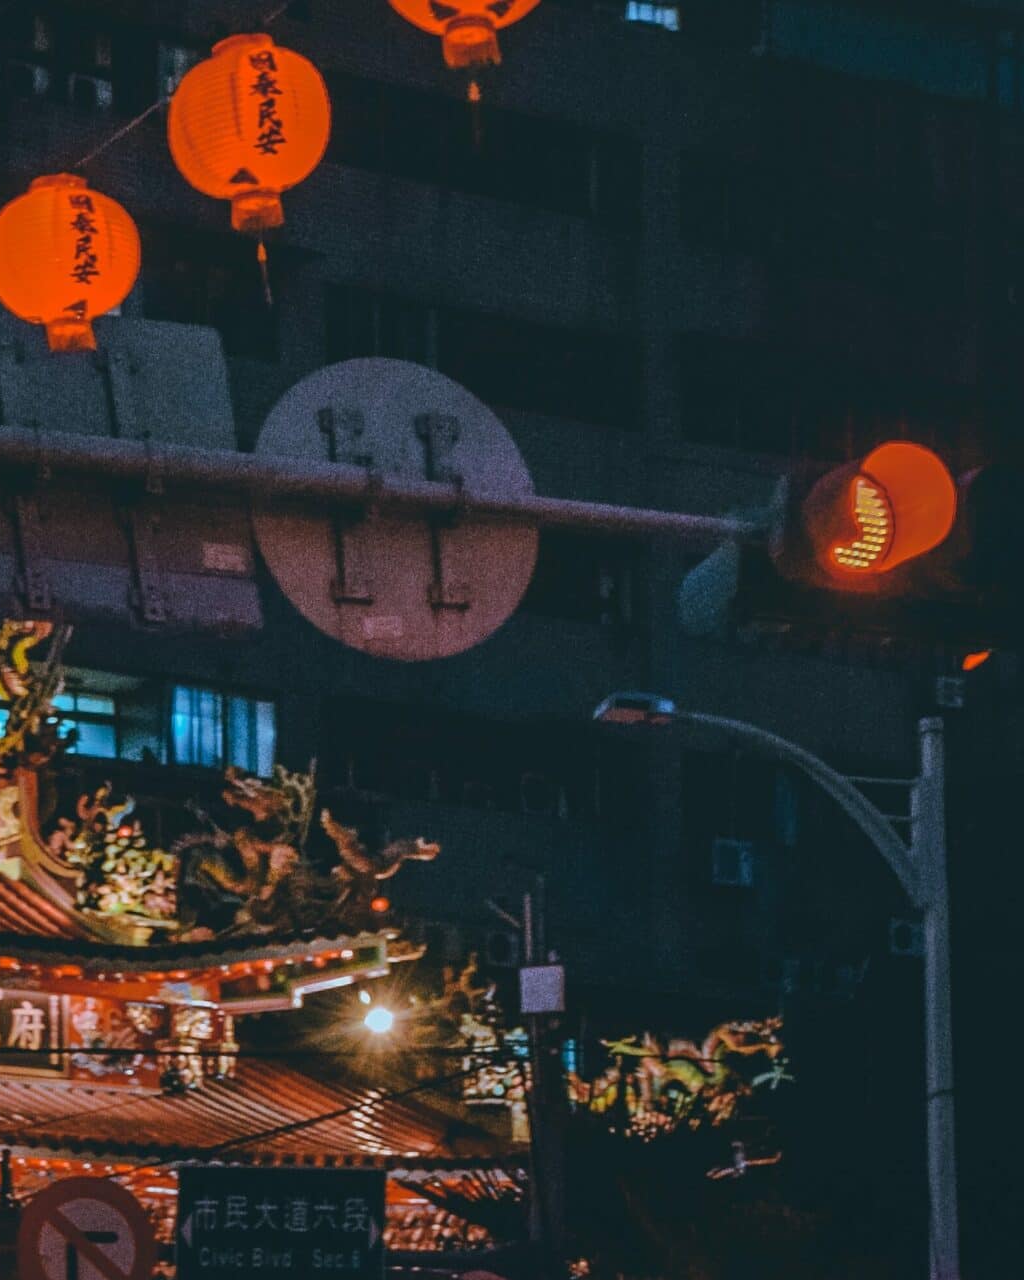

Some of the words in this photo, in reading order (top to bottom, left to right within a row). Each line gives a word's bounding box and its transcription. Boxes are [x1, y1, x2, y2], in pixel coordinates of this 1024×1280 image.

[193, 1195, 369, 1233] 市民大道六段
[199, 1247, 244, 1268] Civic
